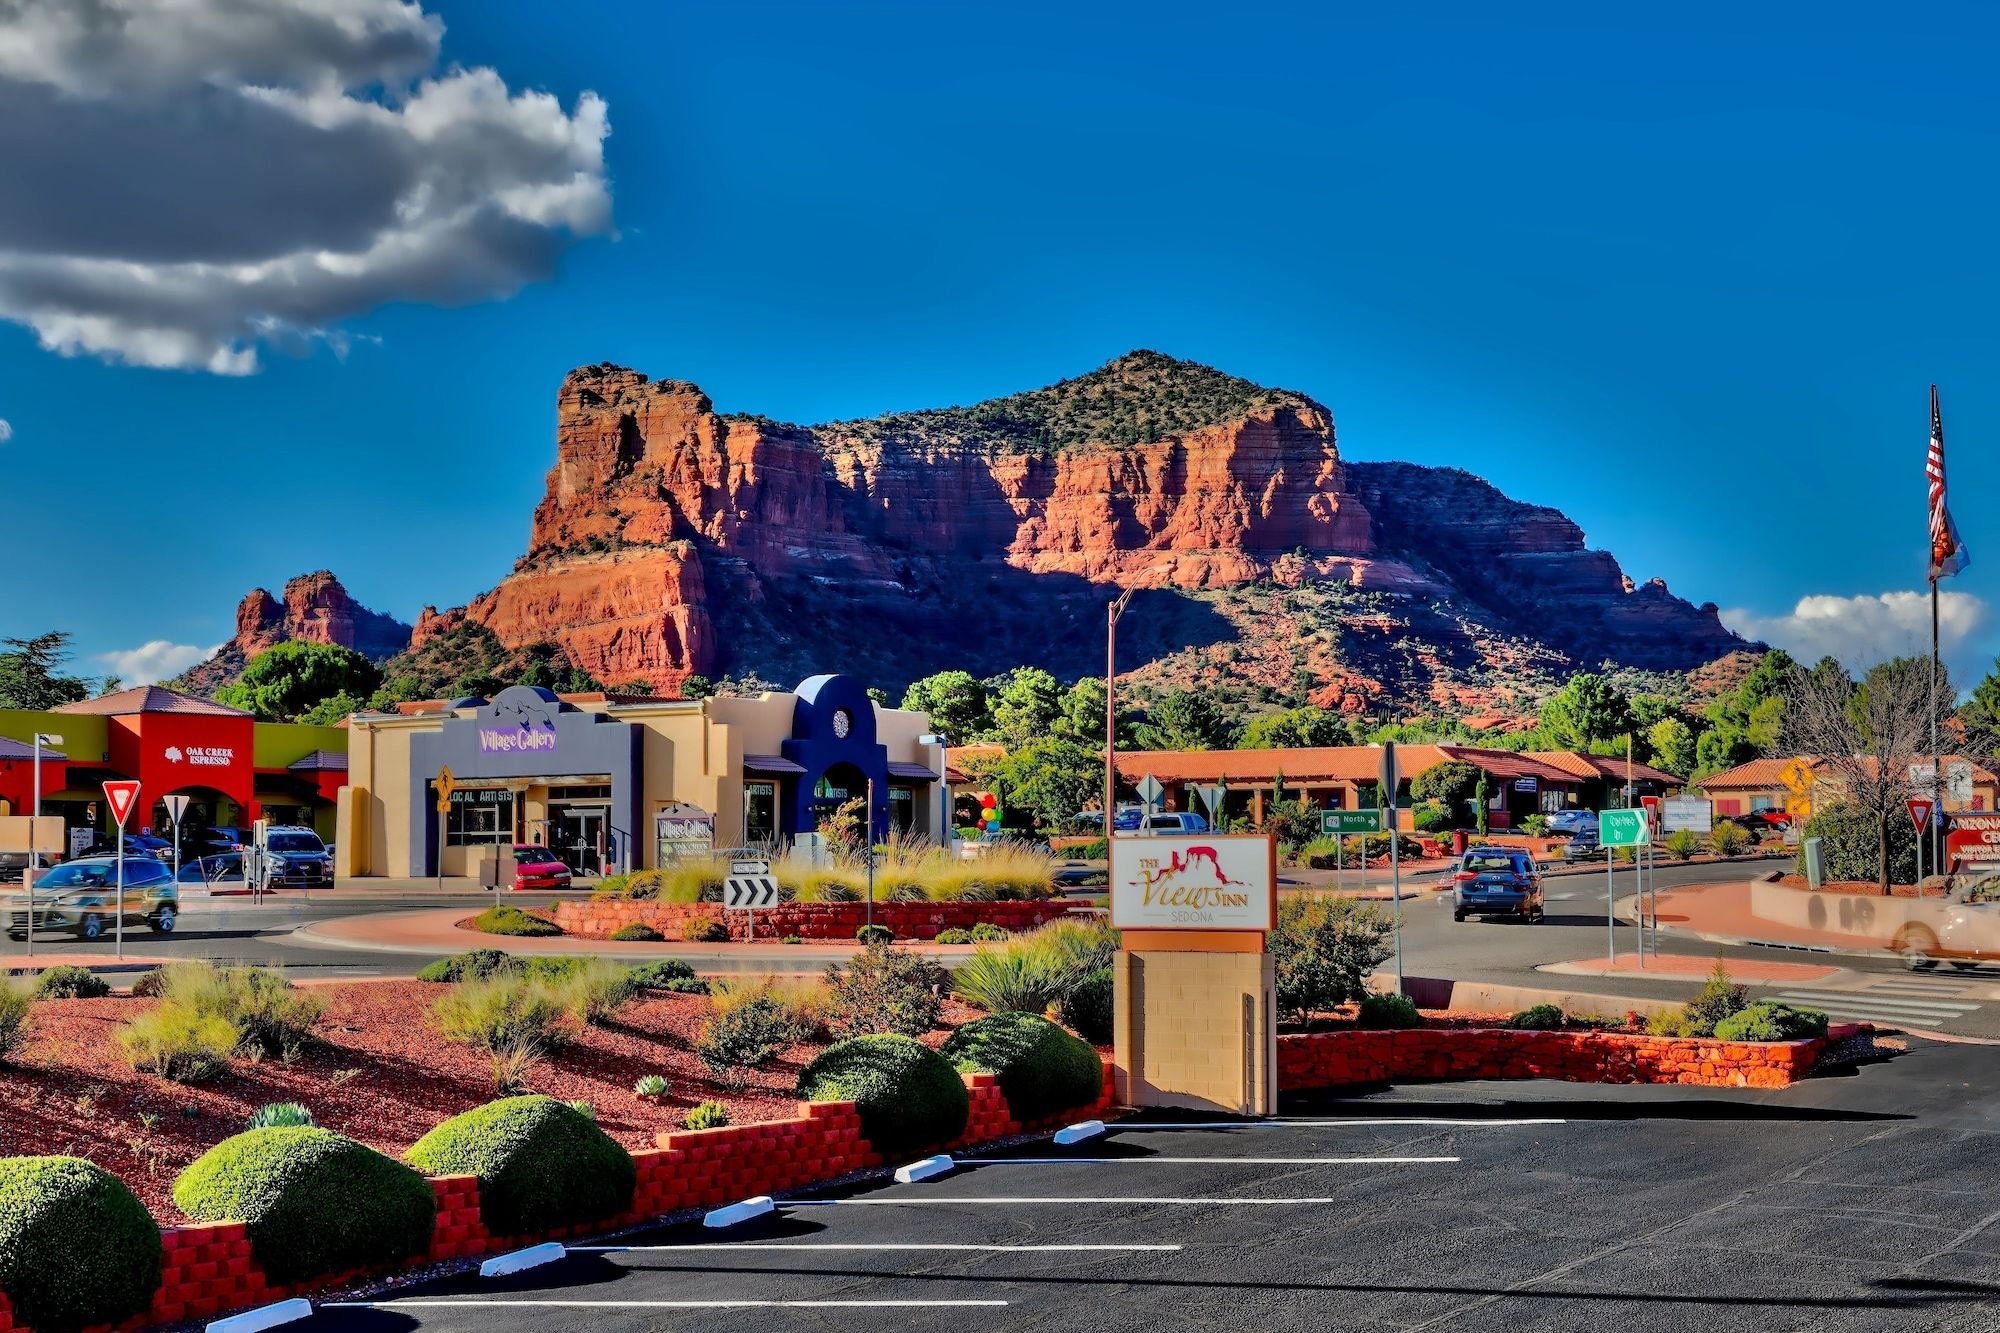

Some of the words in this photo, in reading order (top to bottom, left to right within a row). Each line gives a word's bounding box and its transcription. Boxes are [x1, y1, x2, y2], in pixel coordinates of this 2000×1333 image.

[480, 729, 517, 751] Village
[517, 729, 557, 750] Gallery
[186, 746, 204, 756] OAK
[205, 747, 233, 758] CREEK
[190, 755, 231, 767] ESPRESSO
[480, 791, 513, 802] ARTISTS
[749, 785, 773, 796] ARTISTS
[825, 787, 848, 798] ARTISTS
[1343, 815, 1365, 823] North
[659, 819, 685, 839] Village
[1139, 858, 1160, 868] THE
[1222, 893, 1249, 908] INN
[1171, 911, 1214, 923] SEDONA
